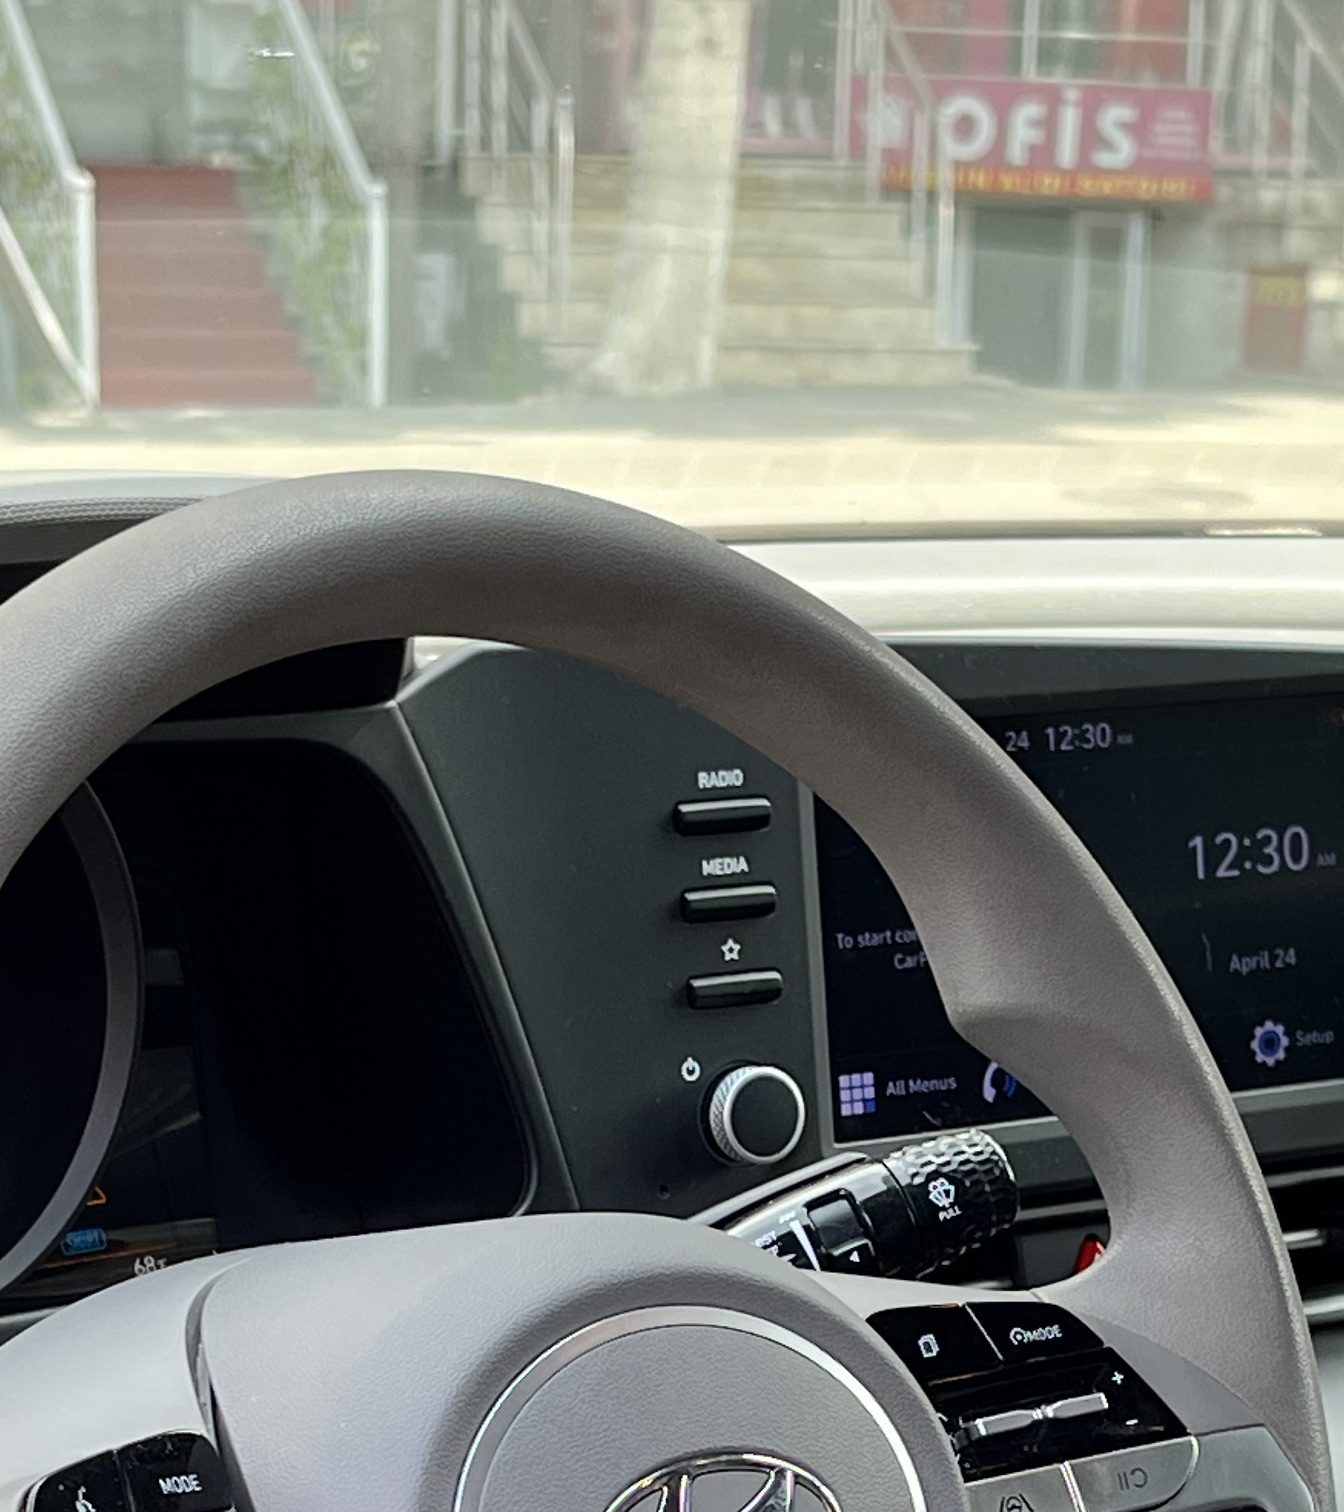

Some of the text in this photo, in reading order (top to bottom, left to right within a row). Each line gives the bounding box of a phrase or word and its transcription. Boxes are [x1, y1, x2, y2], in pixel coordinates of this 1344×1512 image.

[1005, 730, 1030, 752] 24
[1044, 721, 1112, 752] 12:30
[697, 768, 744, 788] RADIO
[1187, 824, 1311, 881] 12:30
[701, 855, 749, 877] MEDIA
[836, 932, 854, 950] To
[857, 929, 892, 948] start
[1229, 948, 1297, 975] April 24
[1295, 1027, 1335, 1048] Setup
[885, 1074, 957, 1097] All Menus
[1024, 1324, 1063, 1341] MODE
[158, 1473, 203, 1495] MODE
